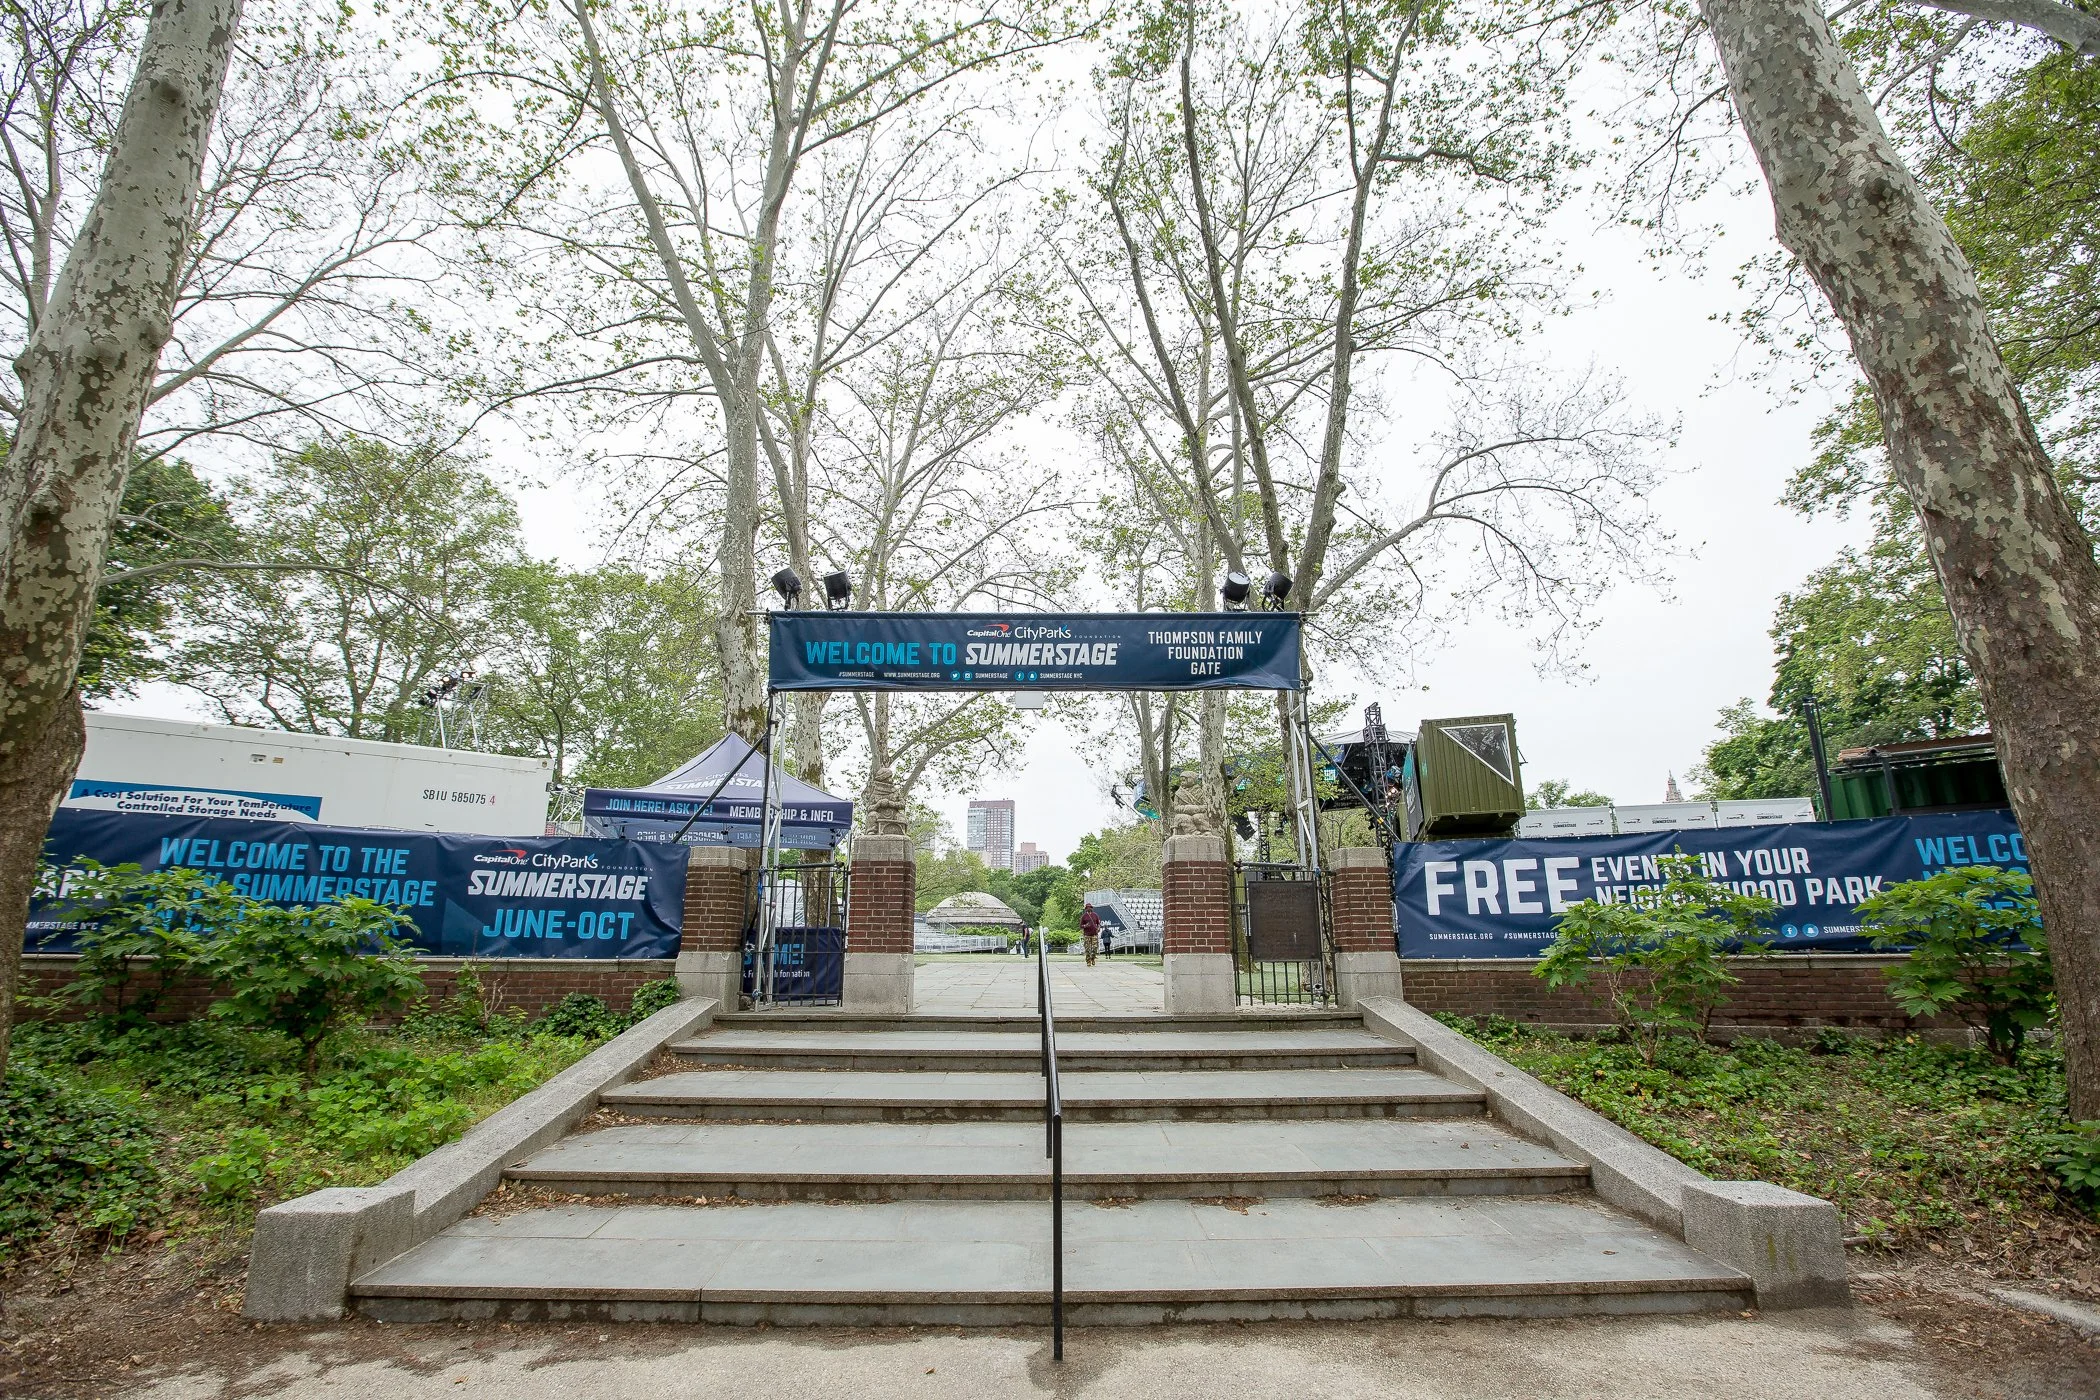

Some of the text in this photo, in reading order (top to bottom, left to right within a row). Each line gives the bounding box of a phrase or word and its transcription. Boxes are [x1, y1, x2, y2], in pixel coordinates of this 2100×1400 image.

[1014, 626, 1072, 640] CityParks
[1147, 631, 1263, 644] THOMPSON FAMILY
[806, 641, 1118, 666] WELCOME TO SUMMERSTAGE
[1168, 646, 1244, 660] FOUNDATION
[1190, 661, 1221, 675] GATE
[80, 788, 90, 797] A
[94, 789, 122, 799] Cool
[126, 791, 178, 803] Solution
[183, 795, 204, 804] For
[207, 796, 234, 807] Your
[451, 792, 486, 805] 585075
[489, 795, 496, 806] 4
[606, 798, 631, 811] JOIN
[633, 800, 665, 813] HERE!
[668, 802, 690, 814] ASK
[117, 800, 278, 819] Controlled Storage Needs
[800, 809, 808, 821] &
[810, 810, 834, 822] INFO
[159, 837, 410, 875] WELCOME TO THE
[1915, 833, 2029, 866] WELCO
[532, 853, 599, 869] CityParks
[1700, 851, 1728, 878] IN
[1733, 847, 1811, 876] YOUR
[232, 873, 437, 907] SUMMERSTAGE
[467, 869, 648, 901] SUMMERSTAGE
[1424, 856, 1585, 916] FREE
[1804, 875, 1883, 906] PARK
[482, 908, 635, 940] JUNE-OCT
